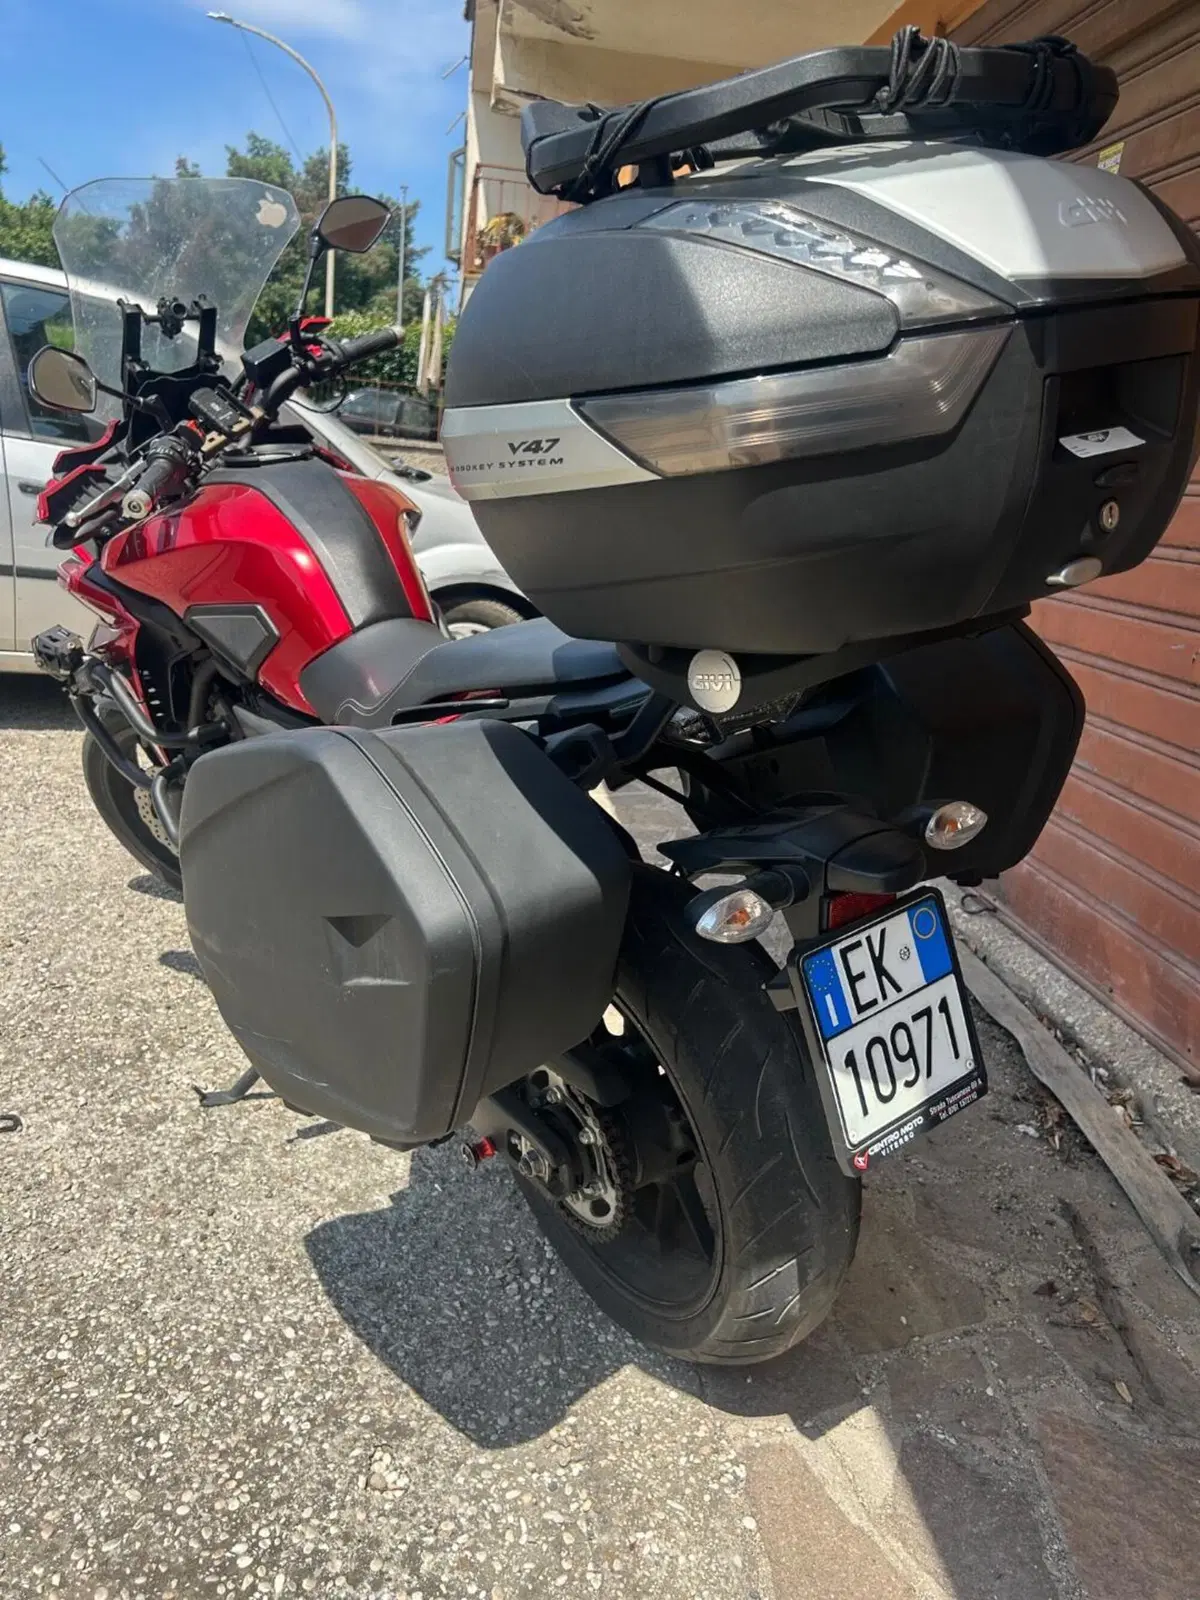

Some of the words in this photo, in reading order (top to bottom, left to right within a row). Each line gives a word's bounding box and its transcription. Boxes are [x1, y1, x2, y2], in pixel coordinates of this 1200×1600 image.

[508, 438, 560, 455] V47
[498, 458, 564, 470] SYSTEM
[692, 673, 732, 693] GIVI
[839, 927, 903, 1015] EK
[824, 994, 839, 1027] I
[844, 996, 960, 1117] 10971
[868, 1131, 899, 1155] CENTRO
[900, 1116, 924, 1135] MOTO
[881, 1131, 914, 1156] VITERBO
